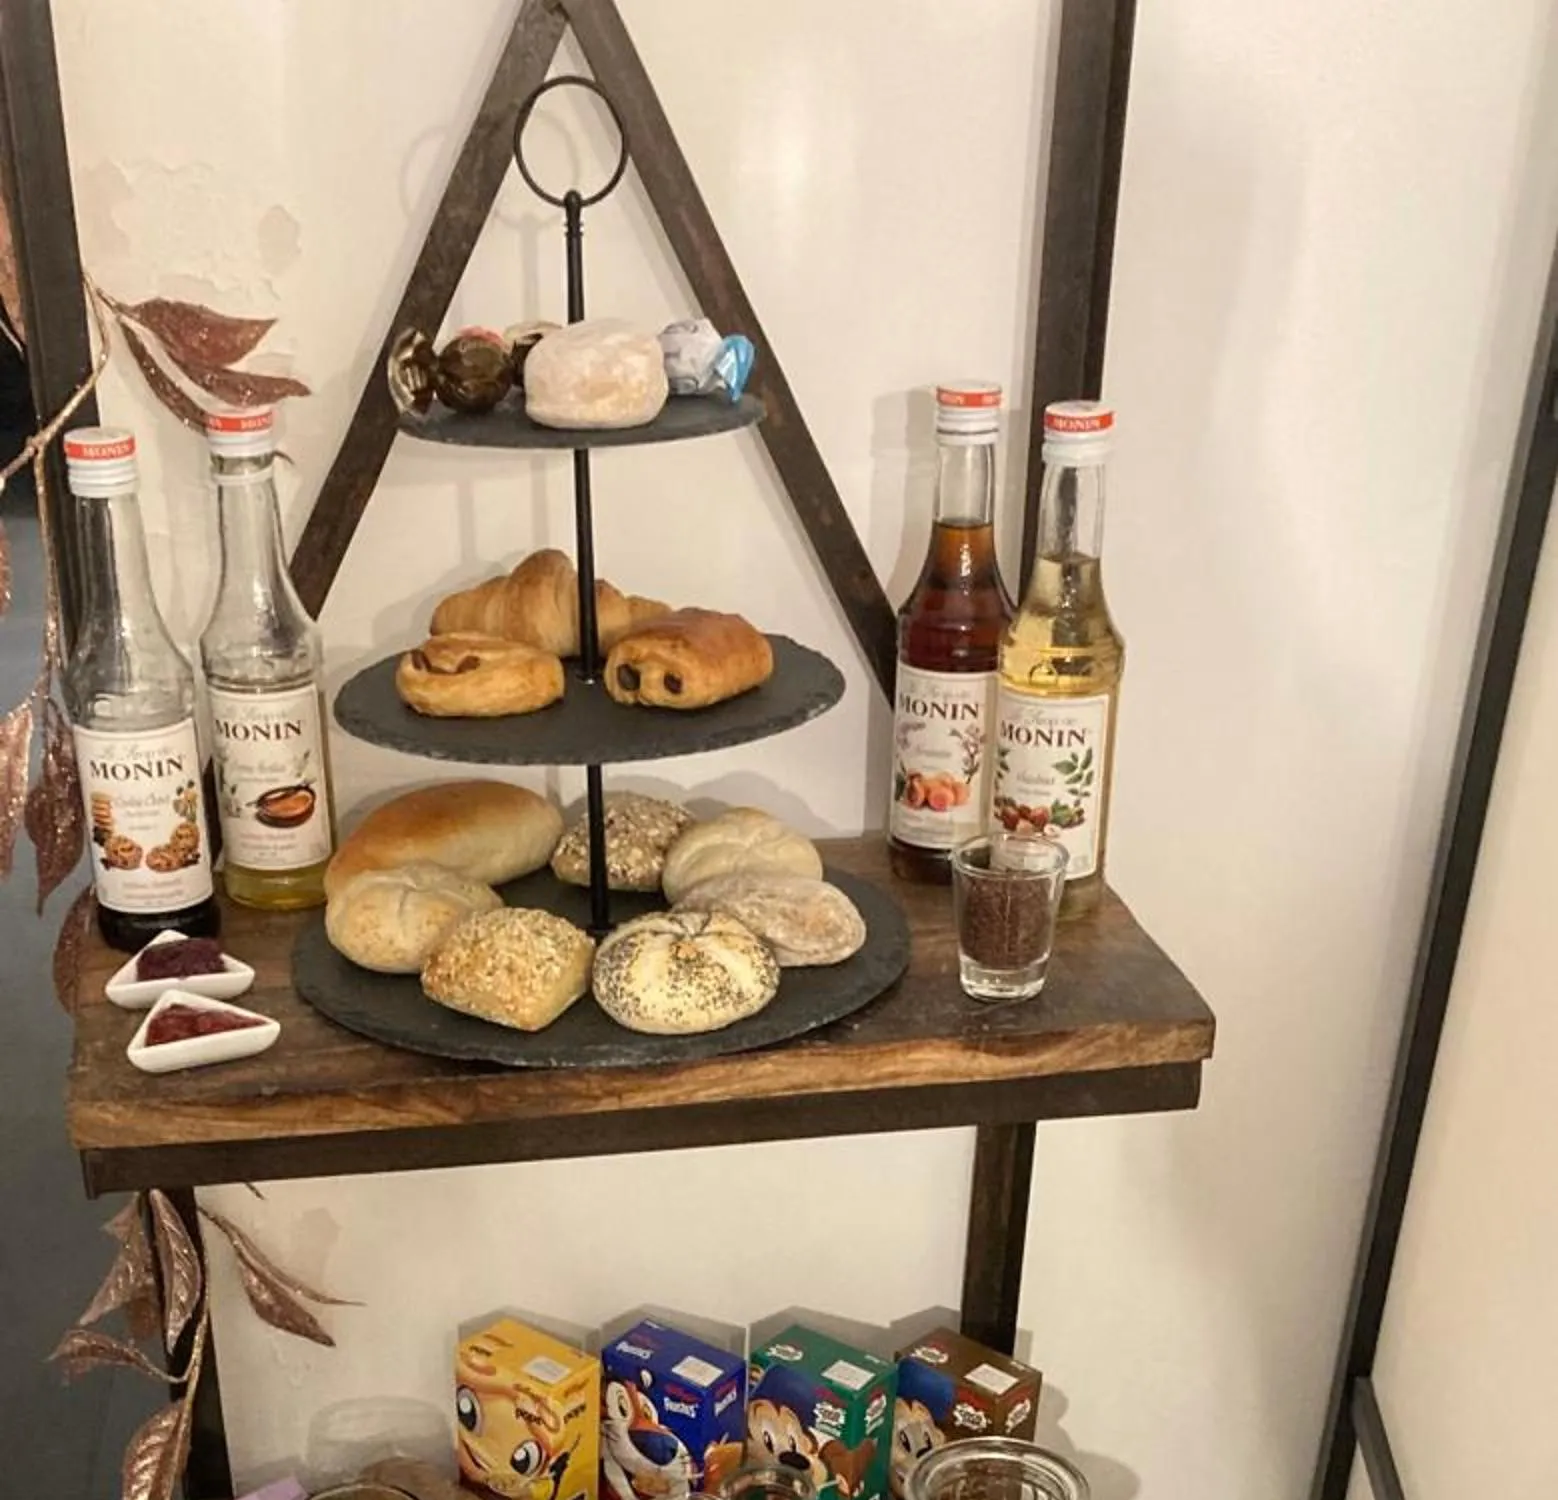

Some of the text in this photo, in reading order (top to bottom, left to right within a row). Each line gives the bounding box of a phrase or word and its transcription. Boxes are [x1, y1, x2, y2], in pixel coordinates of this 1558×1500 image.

[899, 692, 979, 721] MONIN
[214, 718, 303, 742] MONIN
[1000, 719, 1087, 748] MONIN
[89, 753, 184, 781] MONIN
